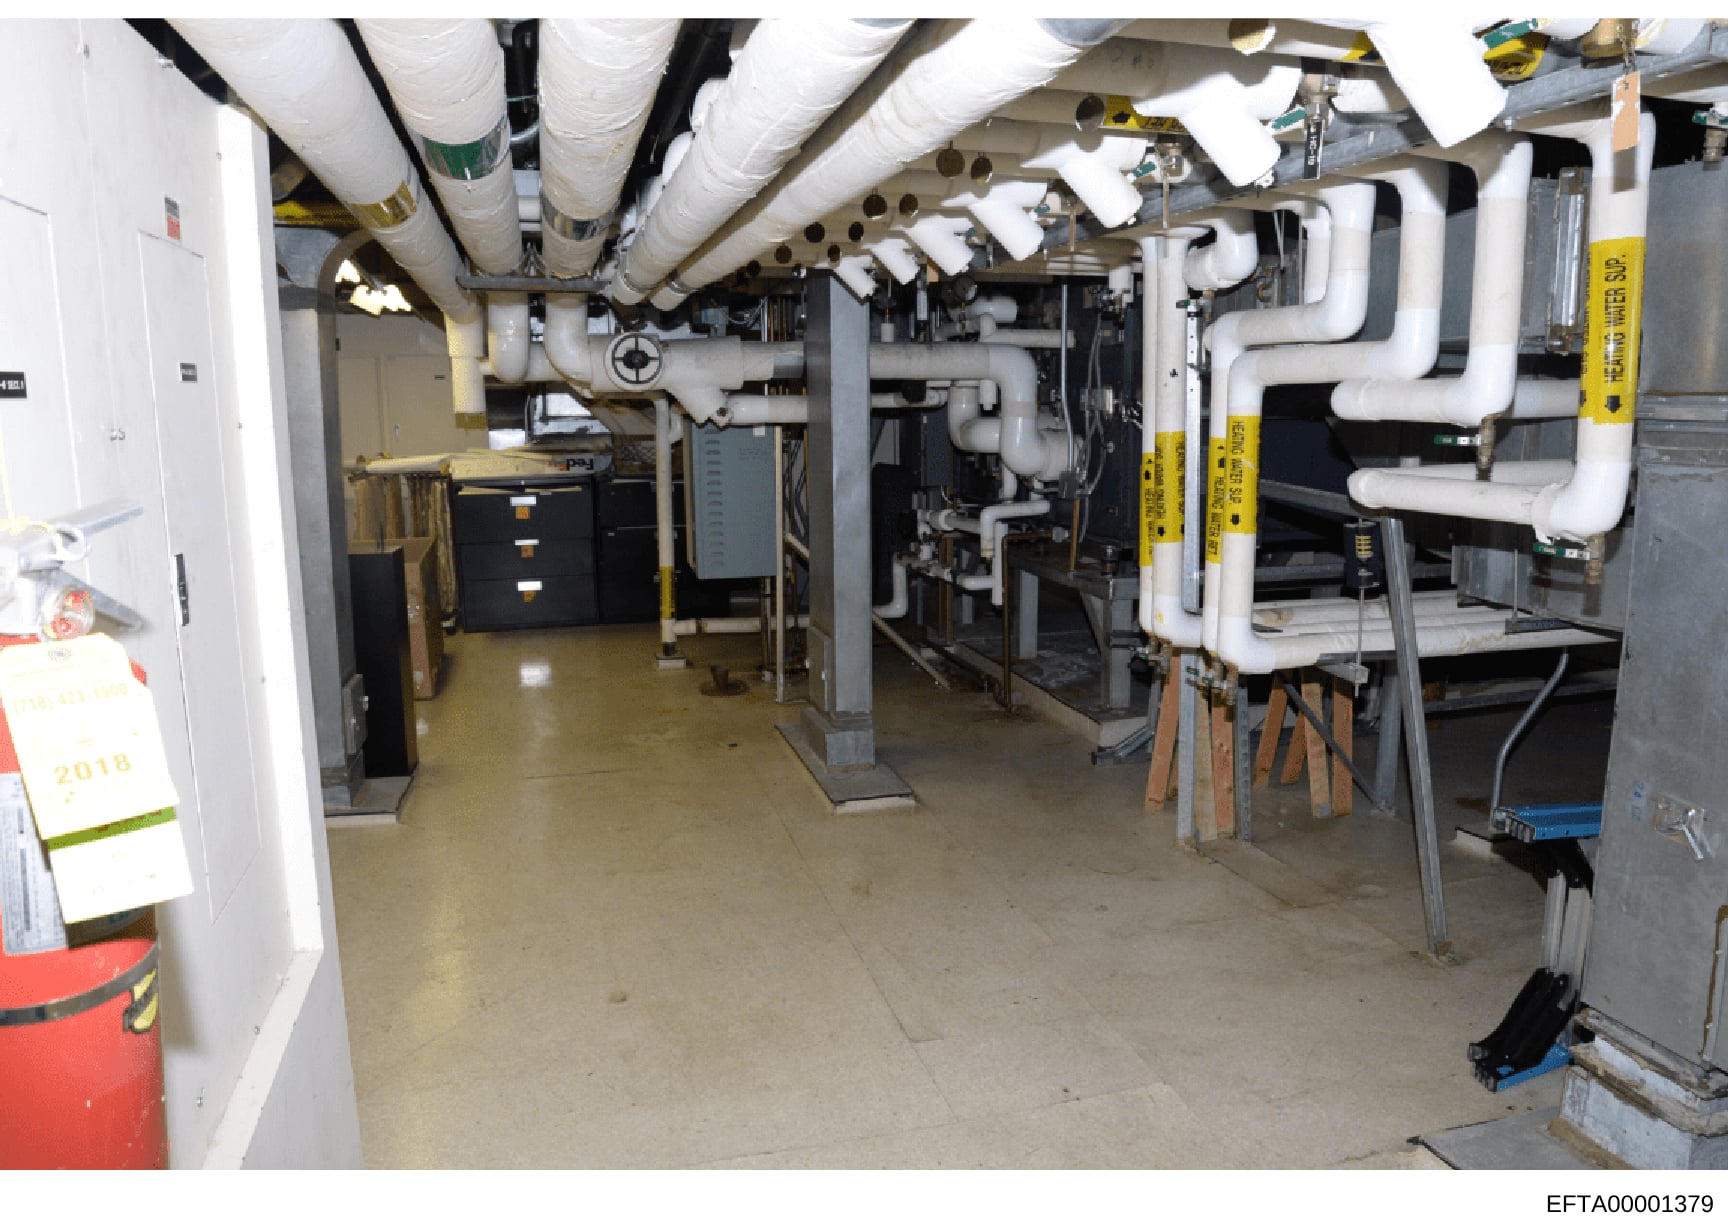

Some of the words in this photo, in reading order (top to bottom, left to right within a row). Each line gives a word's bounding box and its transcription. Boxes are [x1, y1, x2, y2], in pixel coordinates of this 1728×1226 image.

[1604, 254, 1627, 283] SUP.
[1604, 287, 1626, 328] WATER
[1604, 332, 1626, 383] HEATING
[1231, 421, 1245, 455] HEATING
[1230, 458, 1243, 484] WATER
[53, 753, 133, 785] 2018
